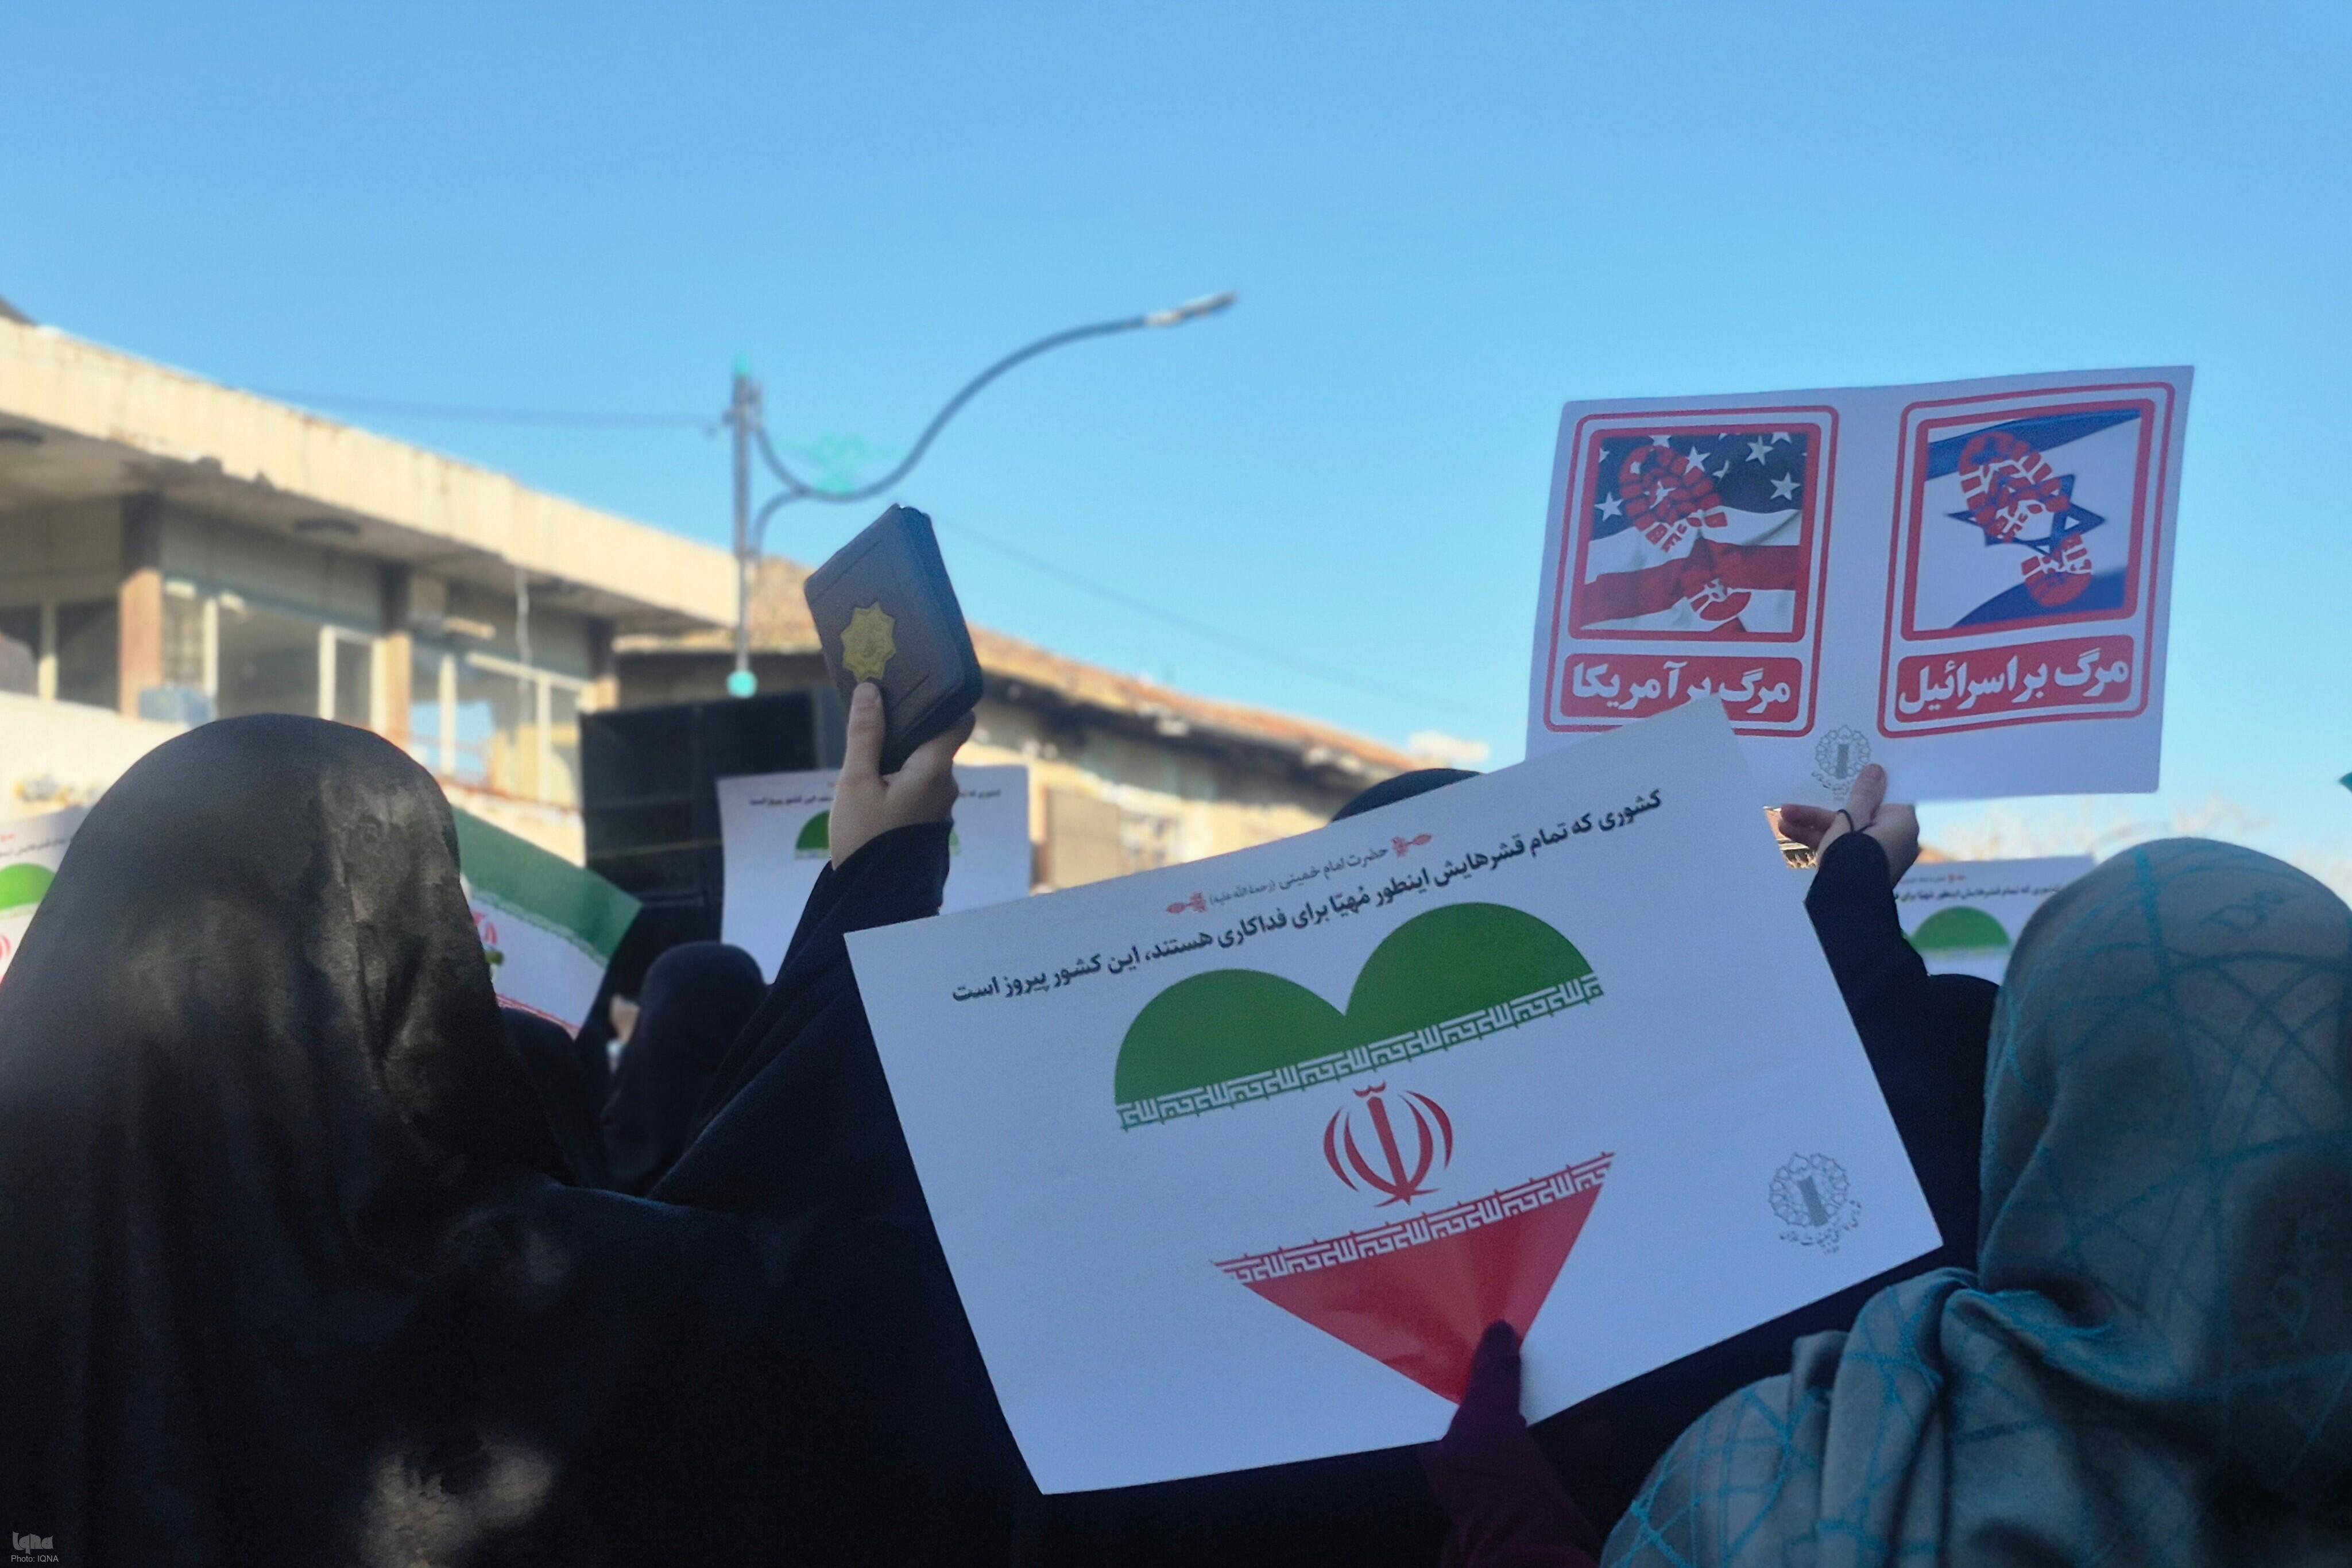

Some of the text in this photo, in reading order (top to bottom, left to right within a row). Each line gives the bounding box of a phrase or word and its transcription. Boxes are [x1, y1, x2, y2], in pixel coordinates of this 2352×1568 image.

[1572, 661, 1688, 710] آمریکا
[1720, 668, 1791, 714] مرگ
[1898, 648, 2129, 714] مرگ بر اسرائیل
[1571, 812, 1592, 835] که
[1598, 788, 1662, 832] کشوری
[1530, 822, 1568, 858] تمام
[1323, 856, 1345, 880] امام
[1347, 847, 1388, 868] حضرت
[1434, 834, 1526, 888] قشرهایش
[1278, 865, 1321, 891] خمینی
[1376, 866, 1430, 907] اینطور
[1217, 907, 1287, 948] فداکاری
[1291, 902, 1330, 929] برای
[1108, 945, 1140, 974] این
[1145, 931, 1213, 961] هستند،
[1003, 973, 1050, 998] پیروز
[1054, 953, 1101, 988] کشور
[952, 976, 1001, 1002] است
